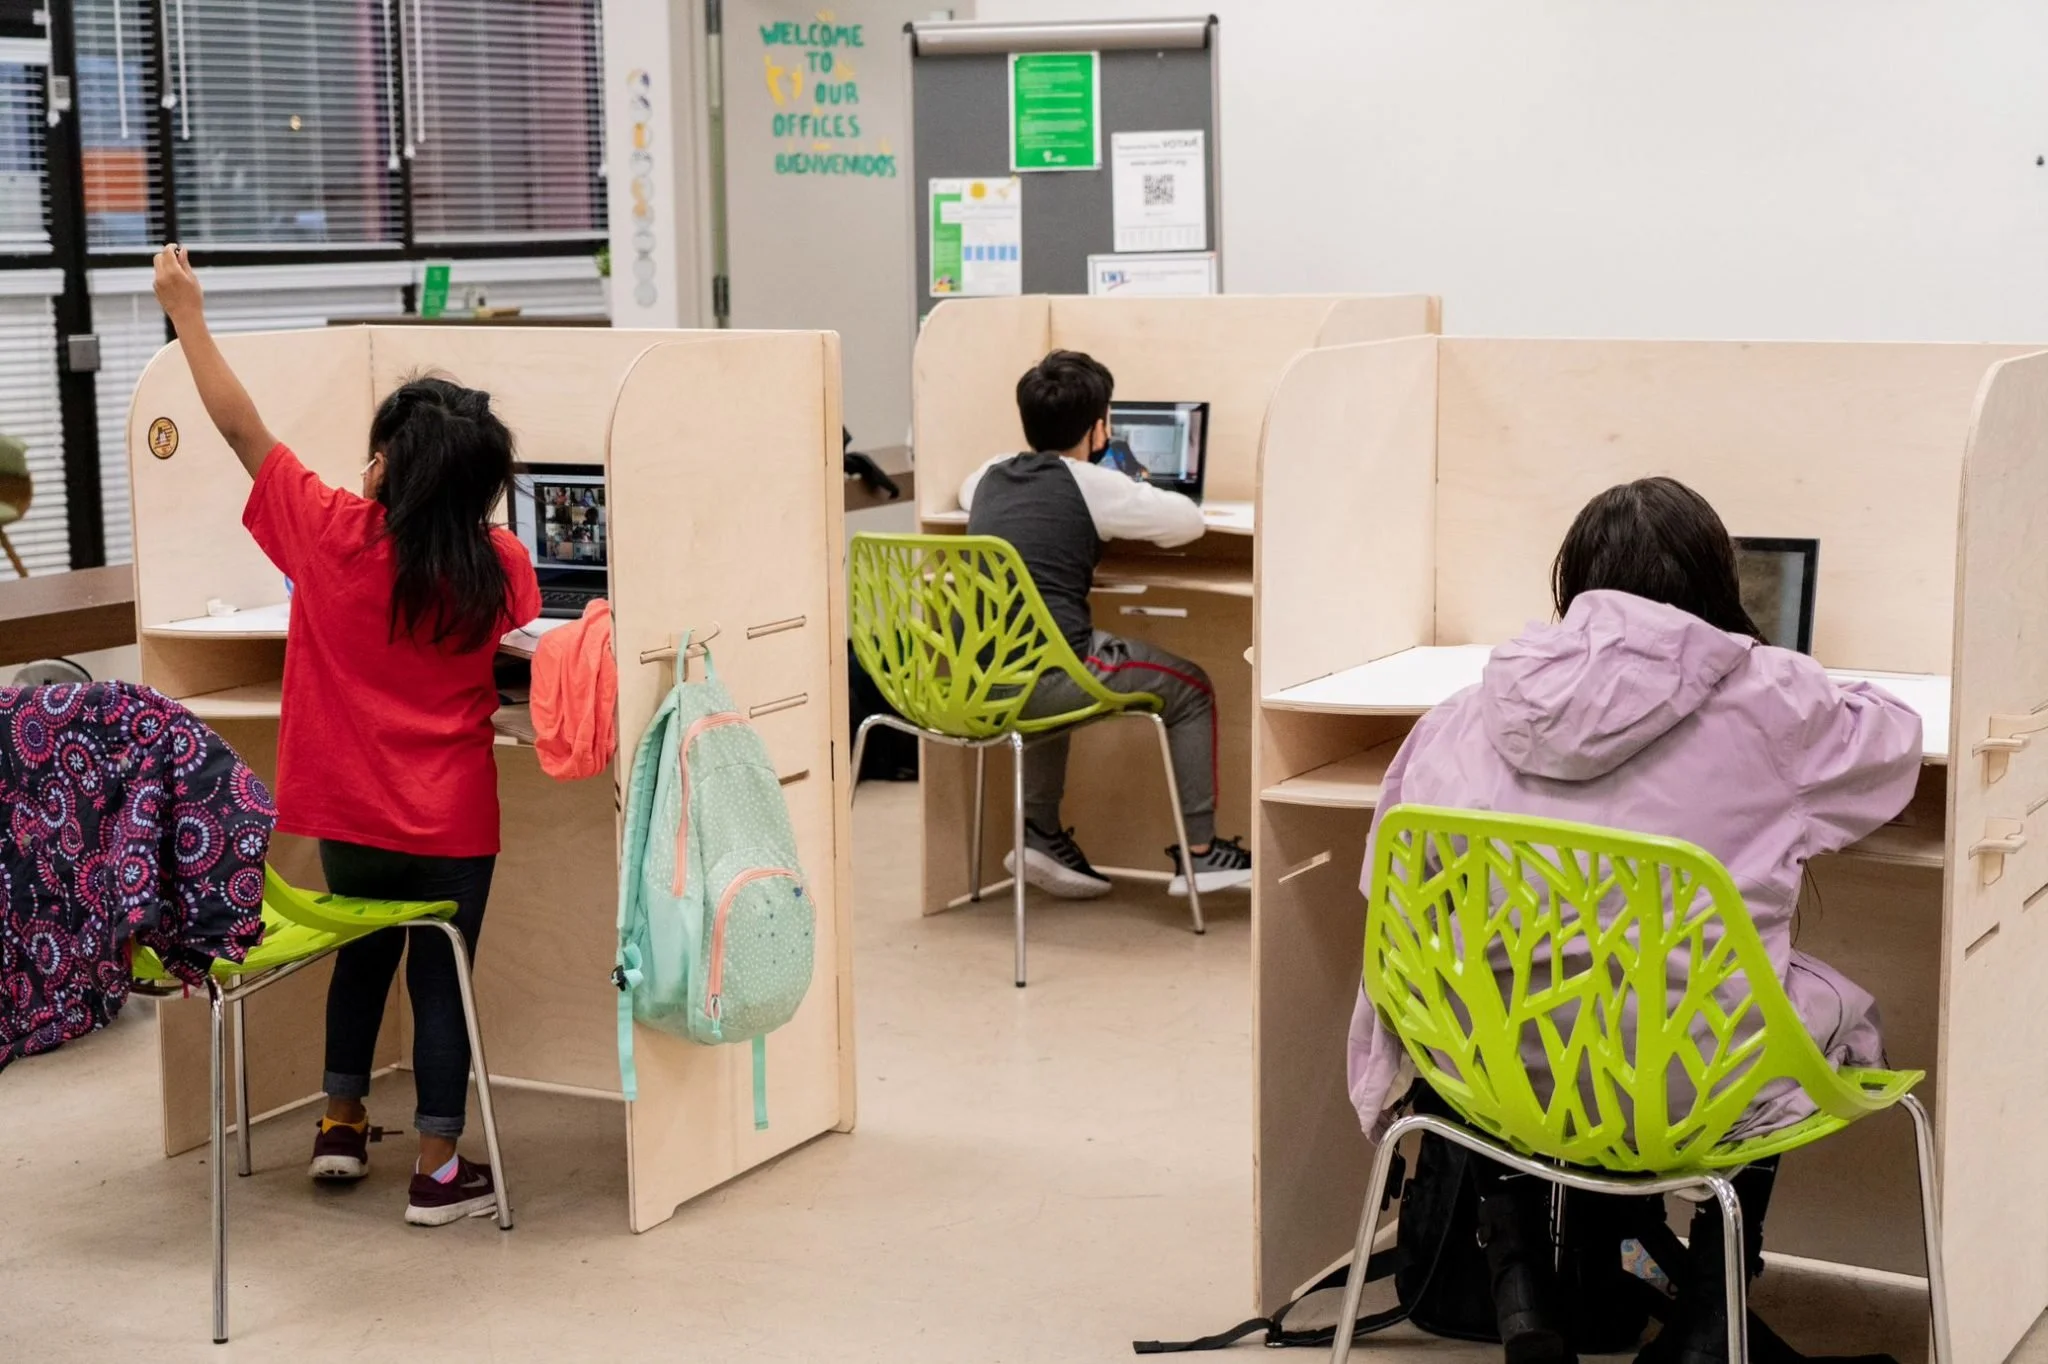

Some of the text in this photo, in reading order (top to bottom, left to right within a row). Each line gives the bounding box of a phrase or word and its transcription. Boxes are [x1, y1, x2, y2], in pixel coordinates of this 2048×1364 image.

[759, 22, 864, 47] WELCOME
[806, 51, 833, 74] TO
[815, 81, 859, 104] OUR
[772, 113, 860, 137] OFFICES
[775, 153, 897, 177] BIENVENIDOS
